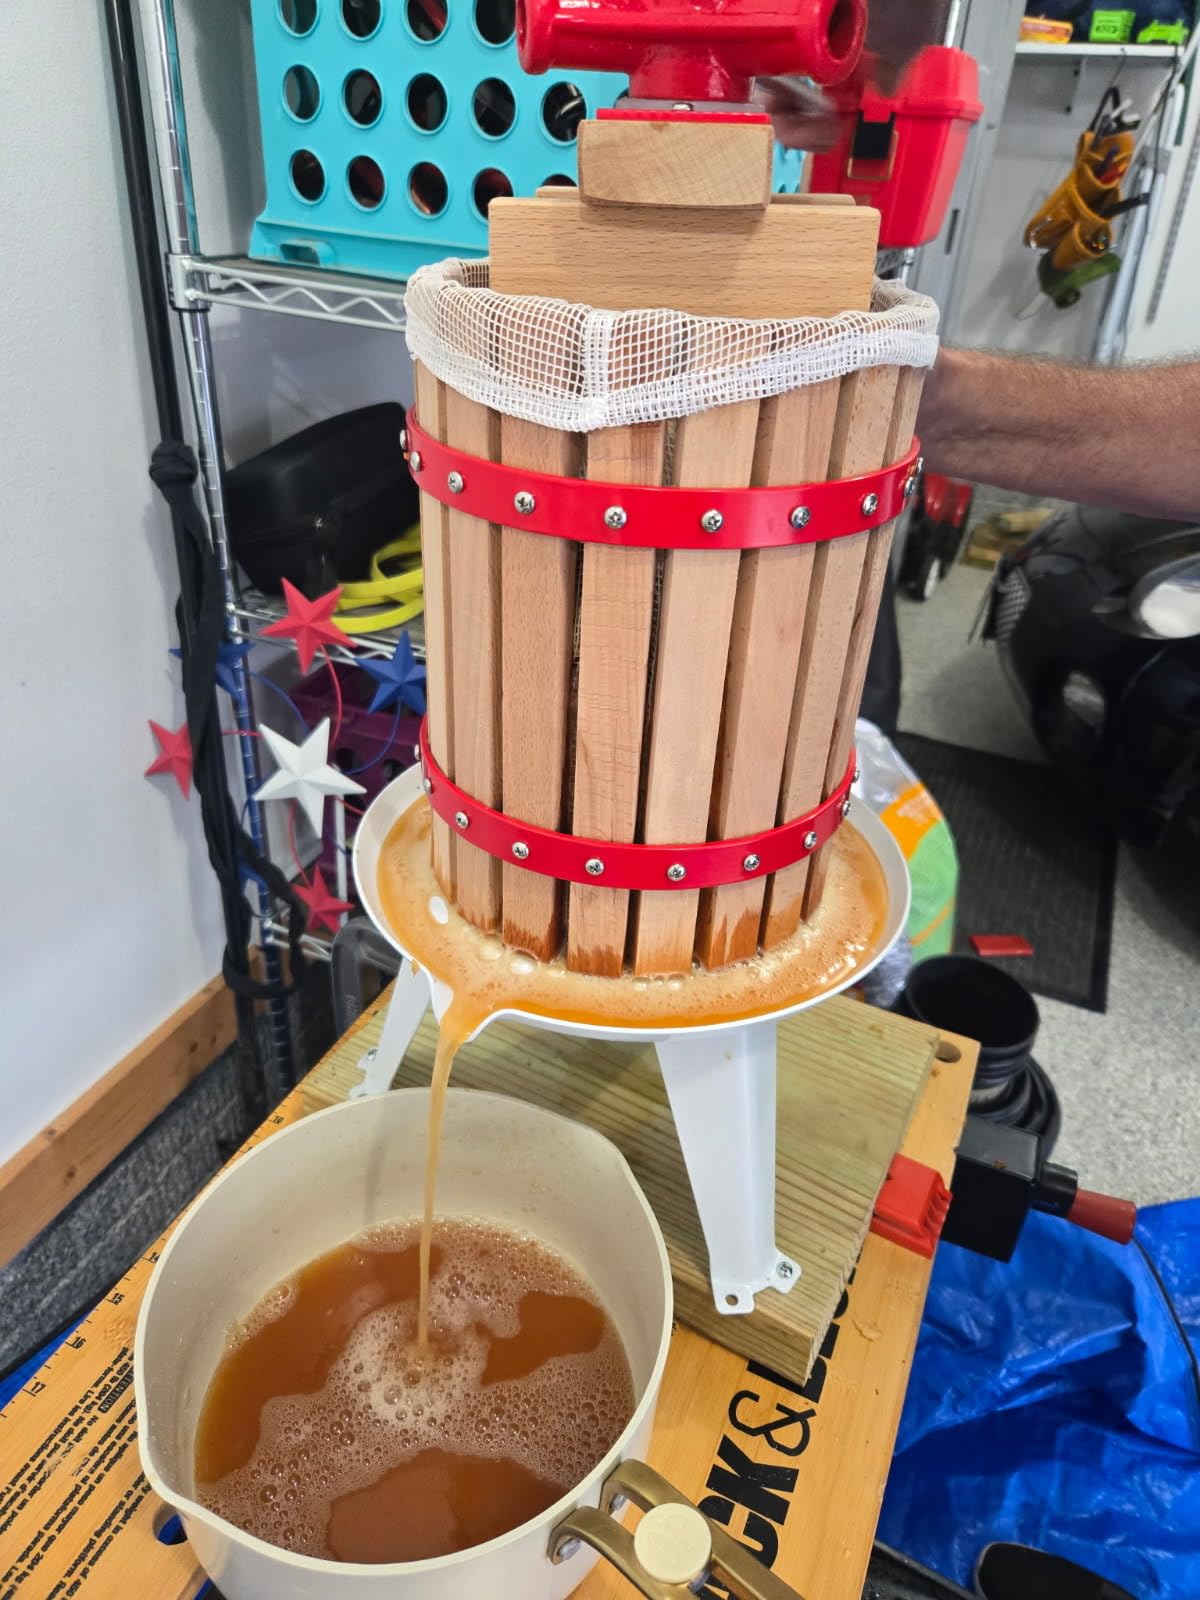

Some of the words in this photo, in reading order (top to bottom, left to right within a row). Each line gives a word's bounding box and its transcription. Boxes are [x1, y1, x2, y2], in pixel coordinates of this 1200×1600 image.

[111, 1293, 124, 1305] 15
[73, 1336, 86, 1348] 16
[30, 1382, 46, 1394] 17
[28, 1416, 71, 1462] instructions
